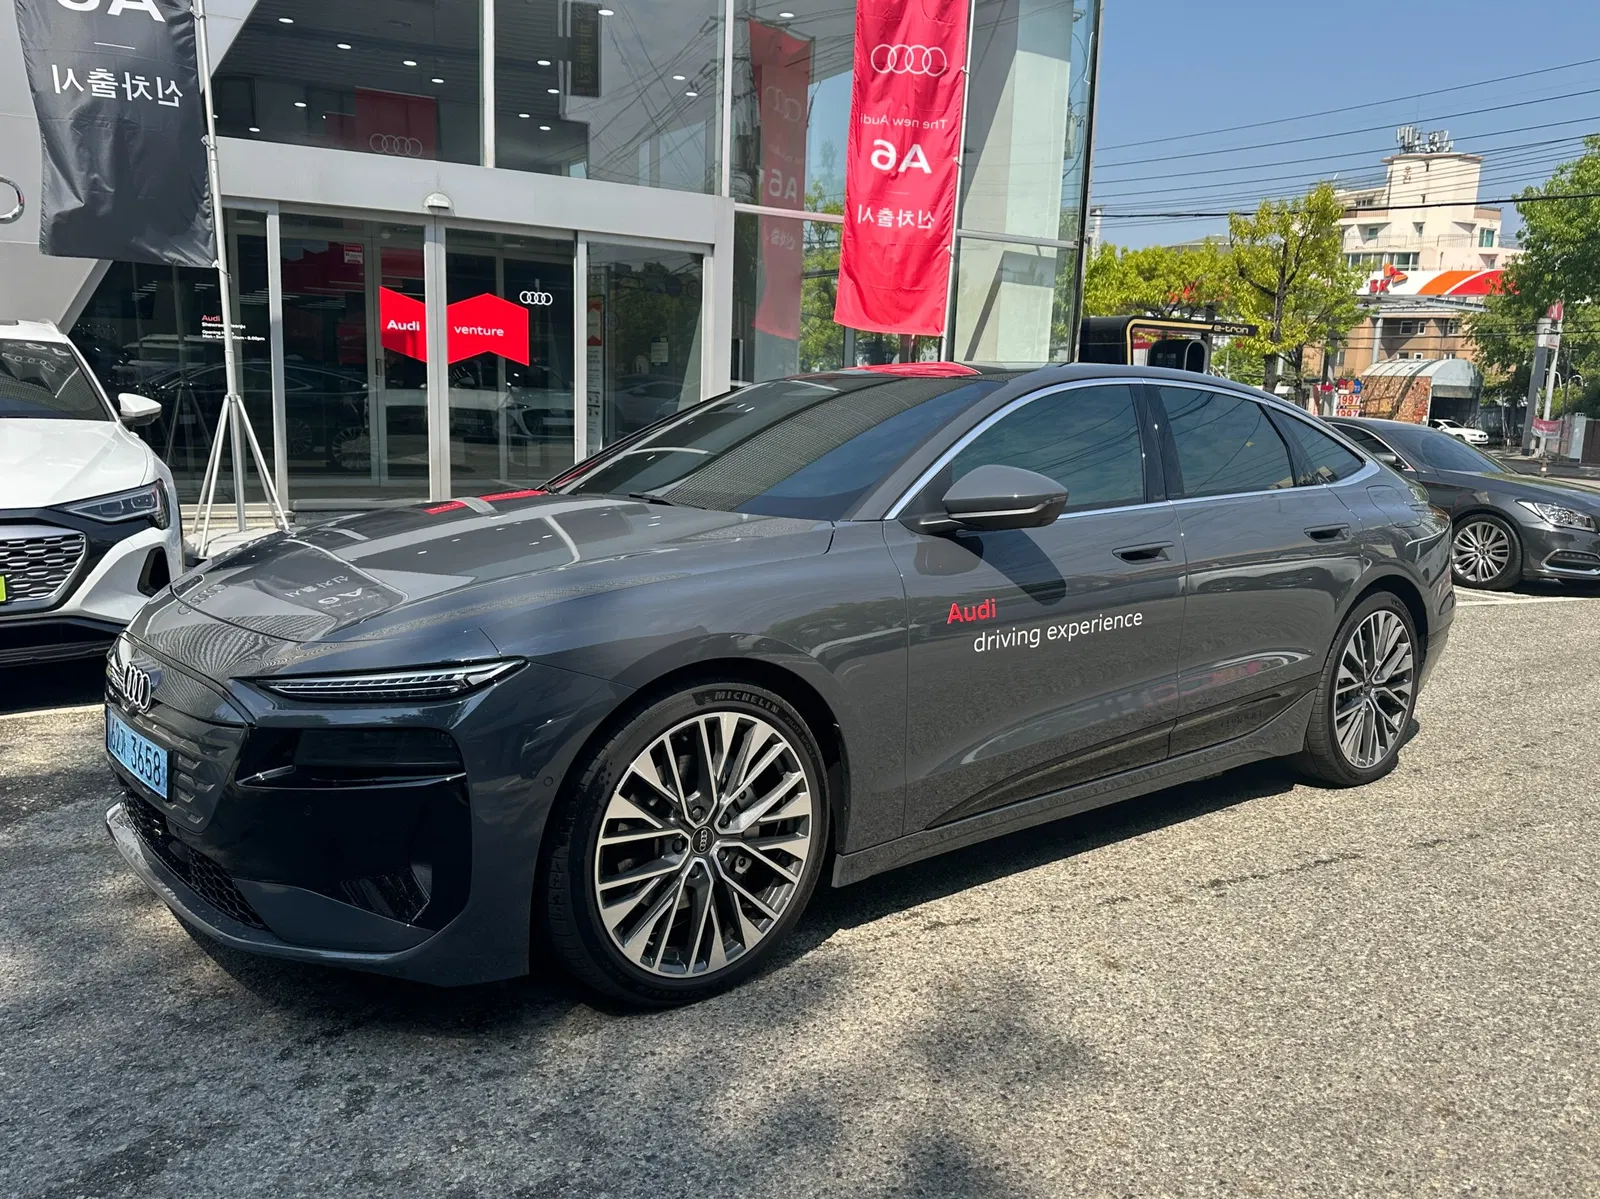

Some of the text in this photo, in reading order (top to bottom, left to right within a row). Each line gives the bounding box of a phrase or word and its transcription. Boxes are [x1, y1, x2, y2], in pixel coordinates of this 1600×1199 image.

[1369, 278, 1391, 293] SK
[201, 314, 221, 322] Audi
[387, 319, 504, 336] Audi venture
[1213, 325, 1249, 335] e-tron
[947, 598, 997, 624] Audi
[973, 612, 1143, 652] driving experience
[714, 690, 780, 714] MICHELIN
[131, 734, 161, 786] 3658
